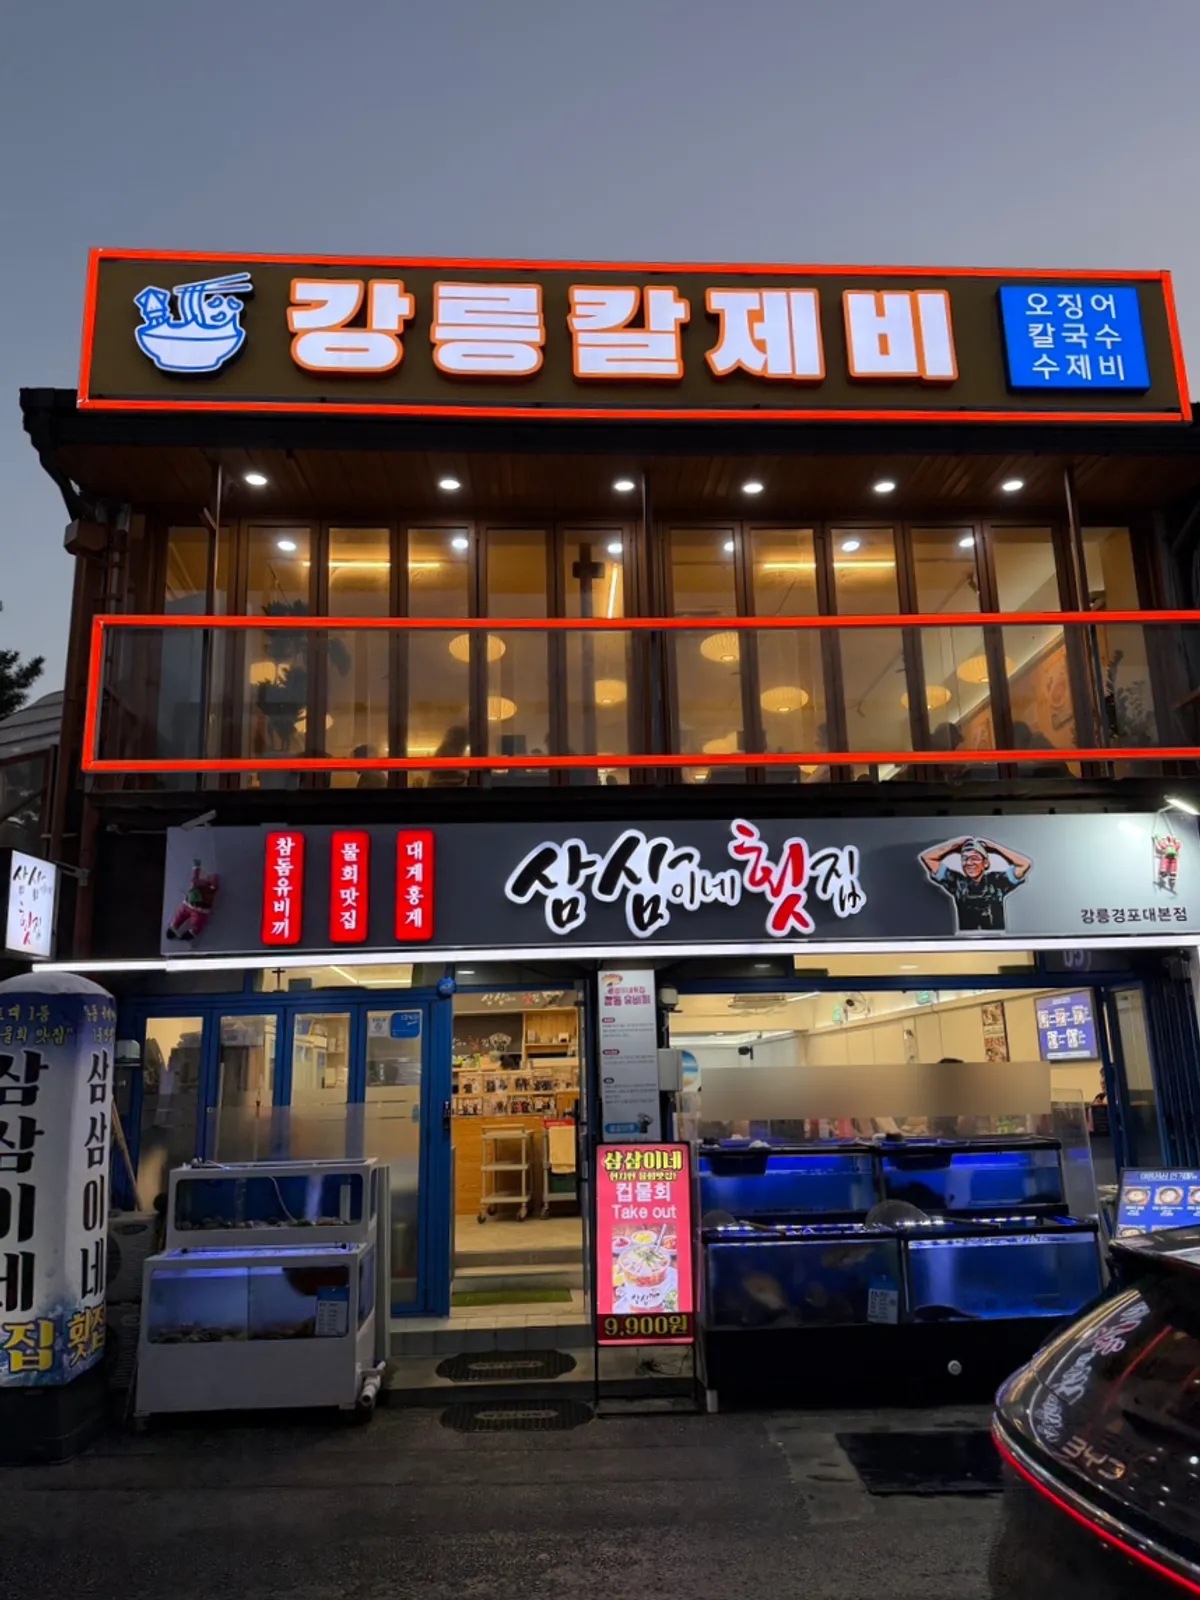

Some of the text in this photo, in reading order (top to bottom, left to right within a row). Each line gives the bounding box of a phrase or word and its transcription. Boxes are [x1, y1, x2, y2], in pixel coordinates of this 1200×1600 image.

[1024, 293, 1118, 320] 오징어
[286, 278, 959, 382] 강릉칼제비
[1027, 322, 1123, 348] 칼국수
[1032, 353, 1126, 382] 수제비
[271, 836, 297, 940] 참돔유비끼
[338, 842, 361, 931] 물회맛집
[403, 839, 425, 929] 대게홍게
[1081, 907, 1187, 924] 강릉경포대본점
[80, 1048, 110, 1301] 삼삼이네
[603, 1150, 683, 1171] 삼삼이네
[616, 1182, 672, 1203] 컵물회
[611, 1205, 677, 1220] Take out
